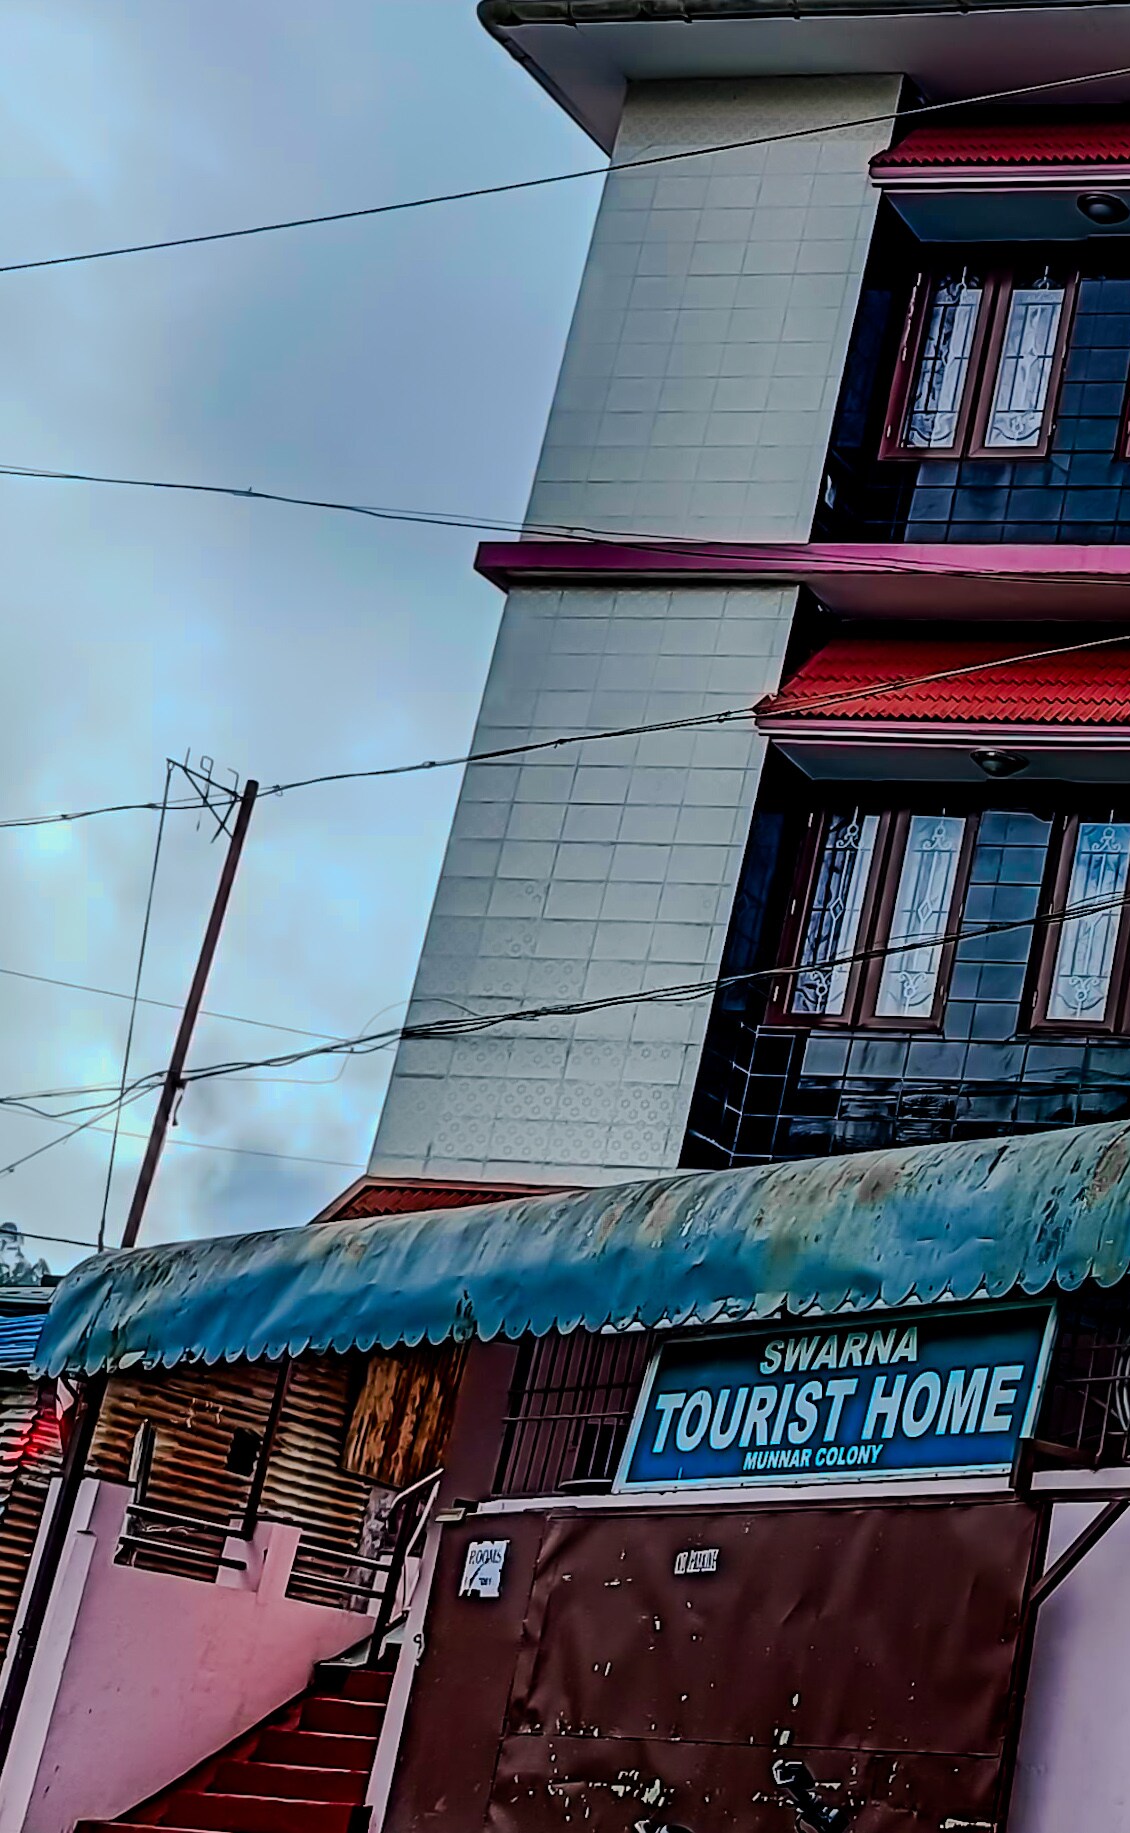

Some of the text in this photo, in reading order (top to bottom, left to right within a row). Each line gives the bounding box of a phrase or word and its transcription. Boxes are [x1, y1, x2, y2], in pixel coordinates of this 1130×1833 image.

[759, 1327, 918, 1374] SWARNA
[652, 1365, 1024, 1453] TOURIST HOME
[743, 1444, 883, 1470] MUNNAR COLONY
